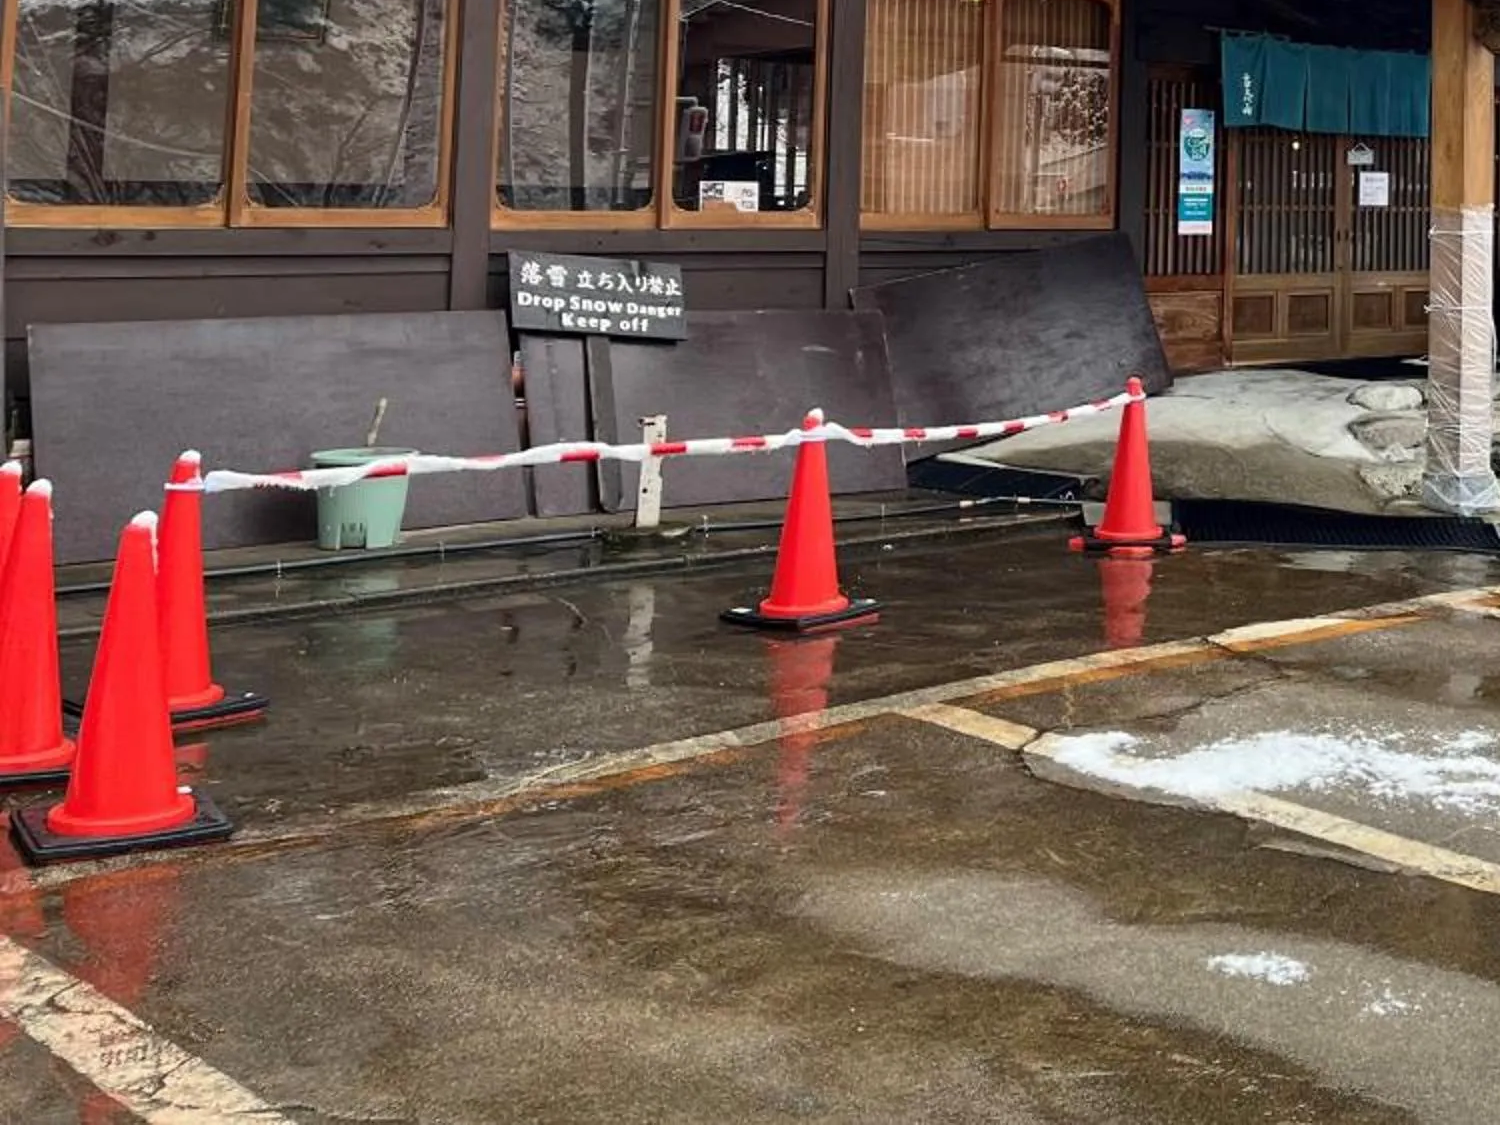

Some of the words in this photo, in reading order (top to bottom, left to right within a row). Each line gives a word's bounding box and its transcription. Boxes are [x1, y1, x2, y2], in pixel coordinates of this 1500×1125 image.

[517, 291, 566, 312] Drop
[569, 295, 623, 313] Snow
[626, 302, 683, 318] Danger
[561, 312, 612, 332] Keep
[619, 317, 650, 332] off
